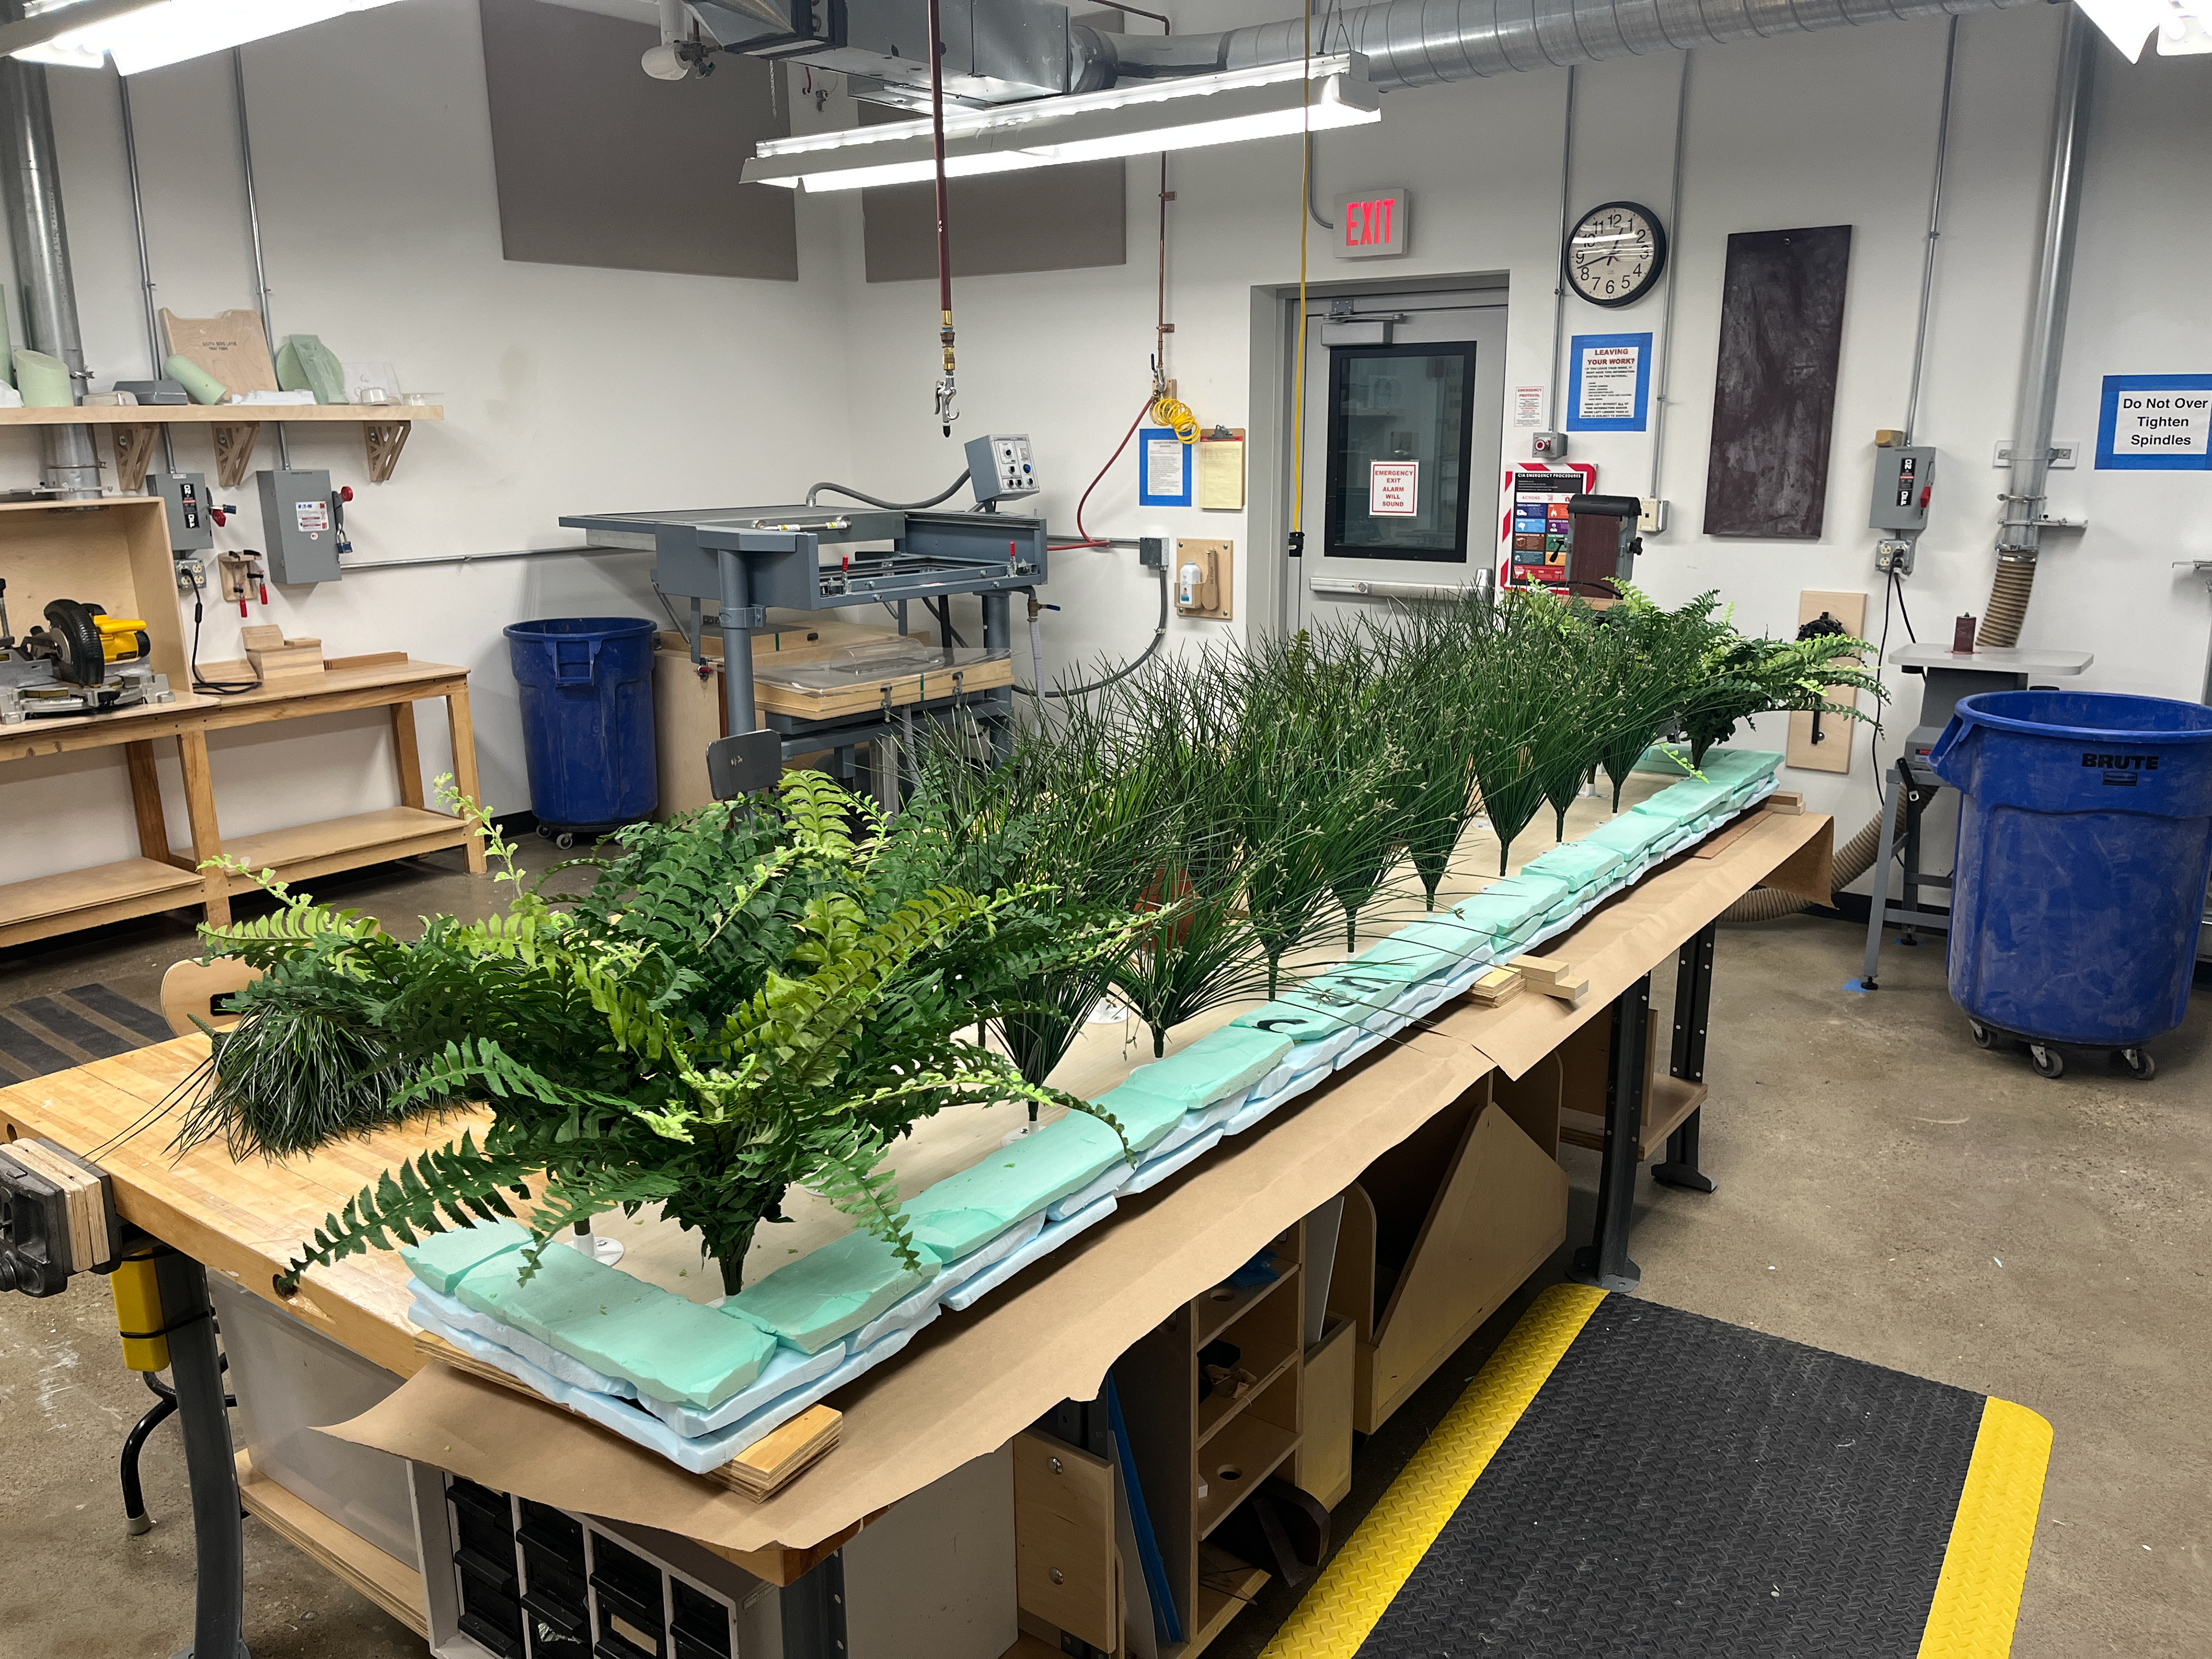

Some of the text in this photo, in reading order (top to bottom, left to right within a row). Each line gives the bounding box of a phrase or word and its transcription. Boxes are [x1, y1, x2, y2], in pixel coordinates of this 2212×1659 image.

[1346, 199, 1395, 246] EXIT
[1593, 221, 1604, 234] 11
[1607, 214, 1622, 228] 12
[1628, 218, 1633, 232] 1
[1636, 229, 1646, 244] 2
[1575, 250, 1585, 264] 9
[1639, 245, 1649, 259] 3
[1581, 267, 1589, 281] 8
[1633, 263, 1642, 277] 4
[1592, 276, 1601, 290] 7
[1605, 280, 1615, 294] 6
[1621, 275, 1631, 289] 5
[2123, 397, 2208, 408] Do Not Over
[2137, 416, 2188, 429] Tighten
[2131, 434, 2191, 448] Spindles
[2082, 753, 2159, 770] BRUTE
